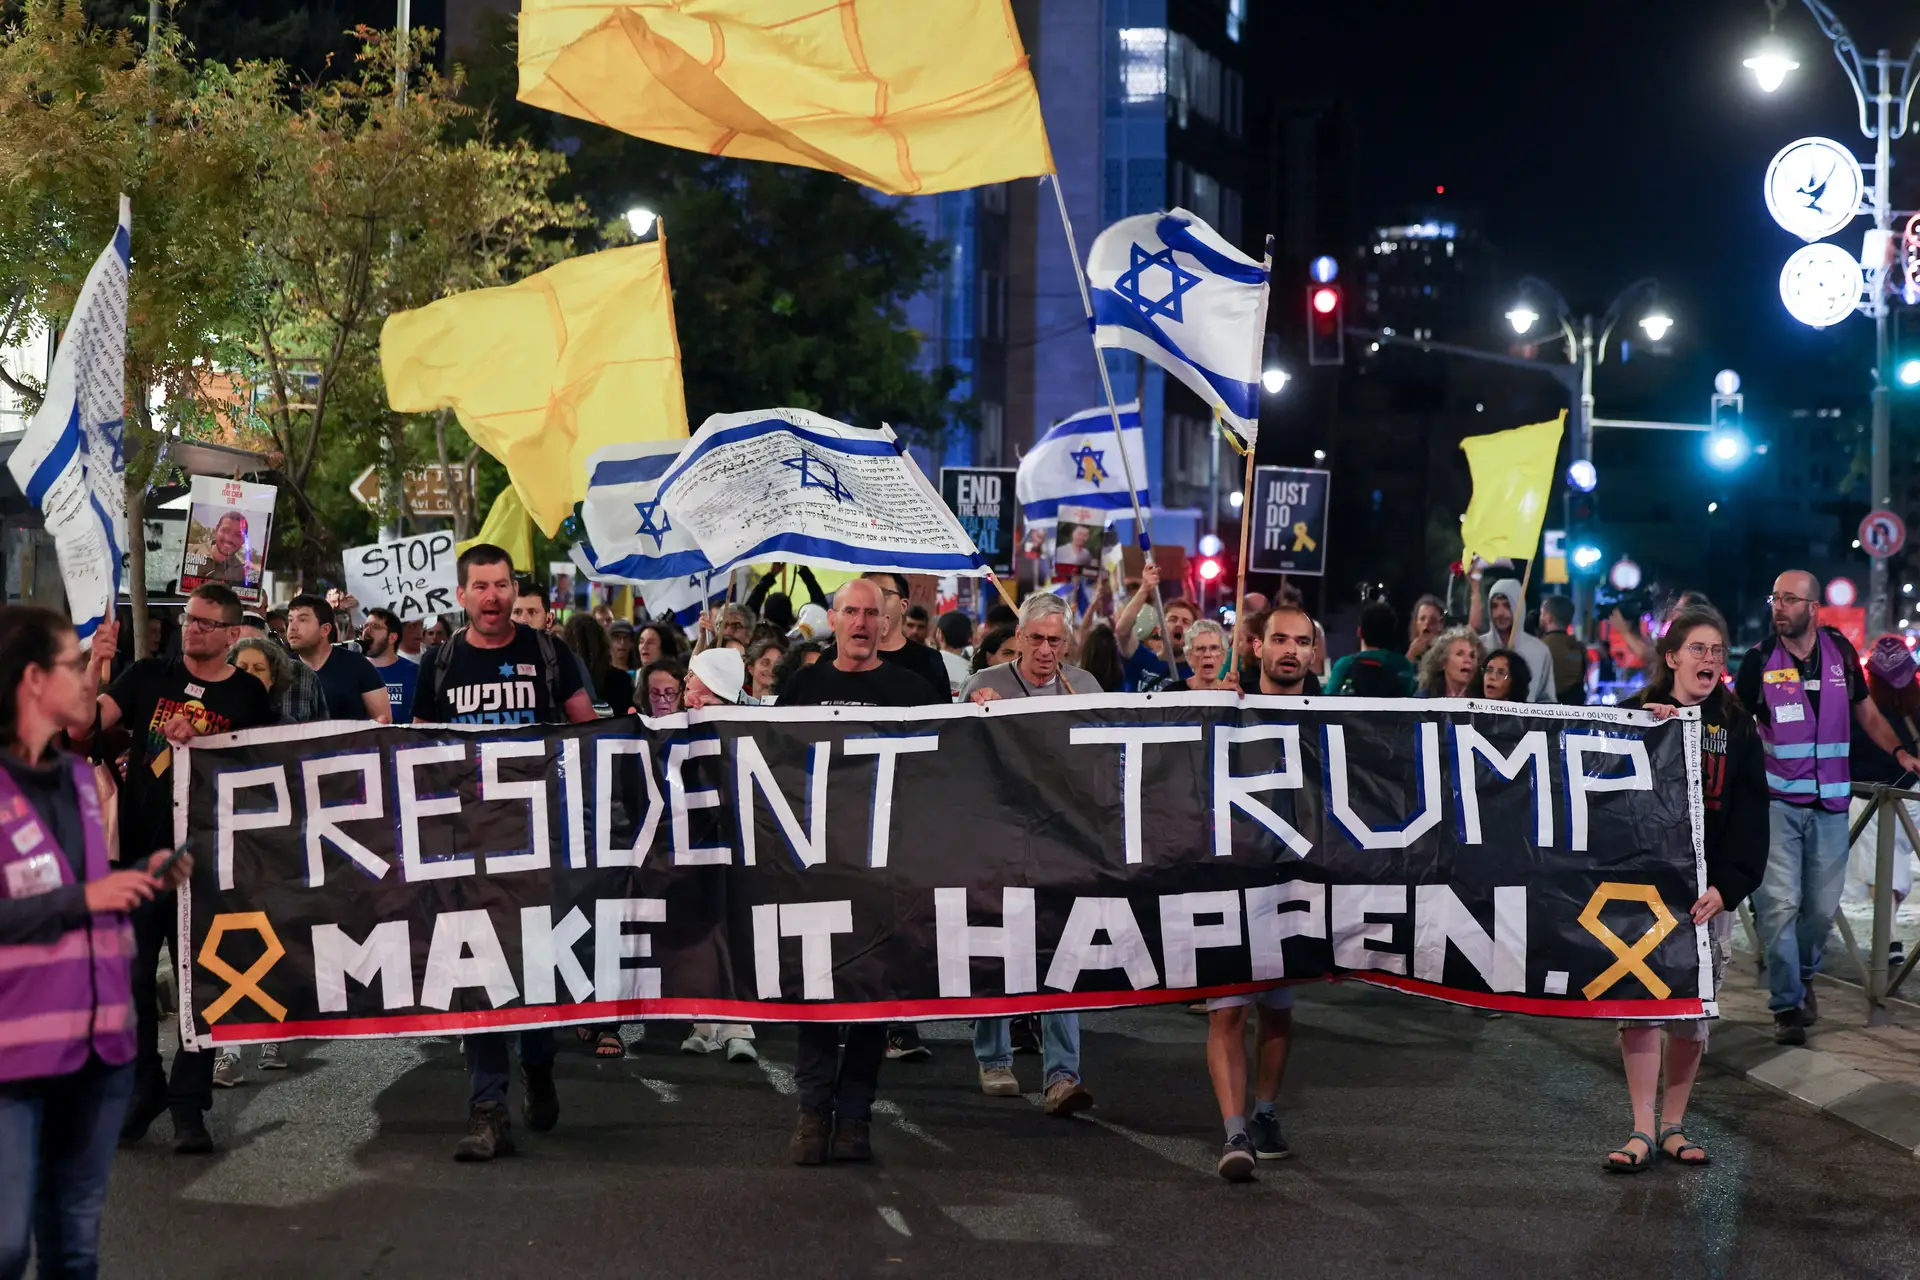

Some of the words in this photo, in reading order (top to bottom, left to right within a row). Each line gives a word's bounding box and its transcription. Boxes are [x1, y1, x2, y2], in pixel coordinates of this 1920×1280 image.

[957, 475, 1002, 505] END
[1267, 481, 1310, 506] JUST
[436, 498, 464, 510] Chi
[957, 503, 976, 517] THE
[976, 504, 1001, 518] WAR
[1266, 504, 1291, 528] DO
[968, 530, 1000, 554] EAL
[1264, 528, 1287, 551] IT.
[186, 552, 207, 566] BRING
[361, 535, 451, 577] STOP
[184, 563, 199, 576] HIM
[382, 576, 430, 595] the
[446, 680, 536, 714] חופשי
[213, 733, 940, 891] PRESIDENT
[1068, 720, 1653, 864] TRUMP
[310, 897, 668, 1013] MAKE
[751, 899, 854, 1000] IT
[932, 879, 1569, 999] HAPPEN.
